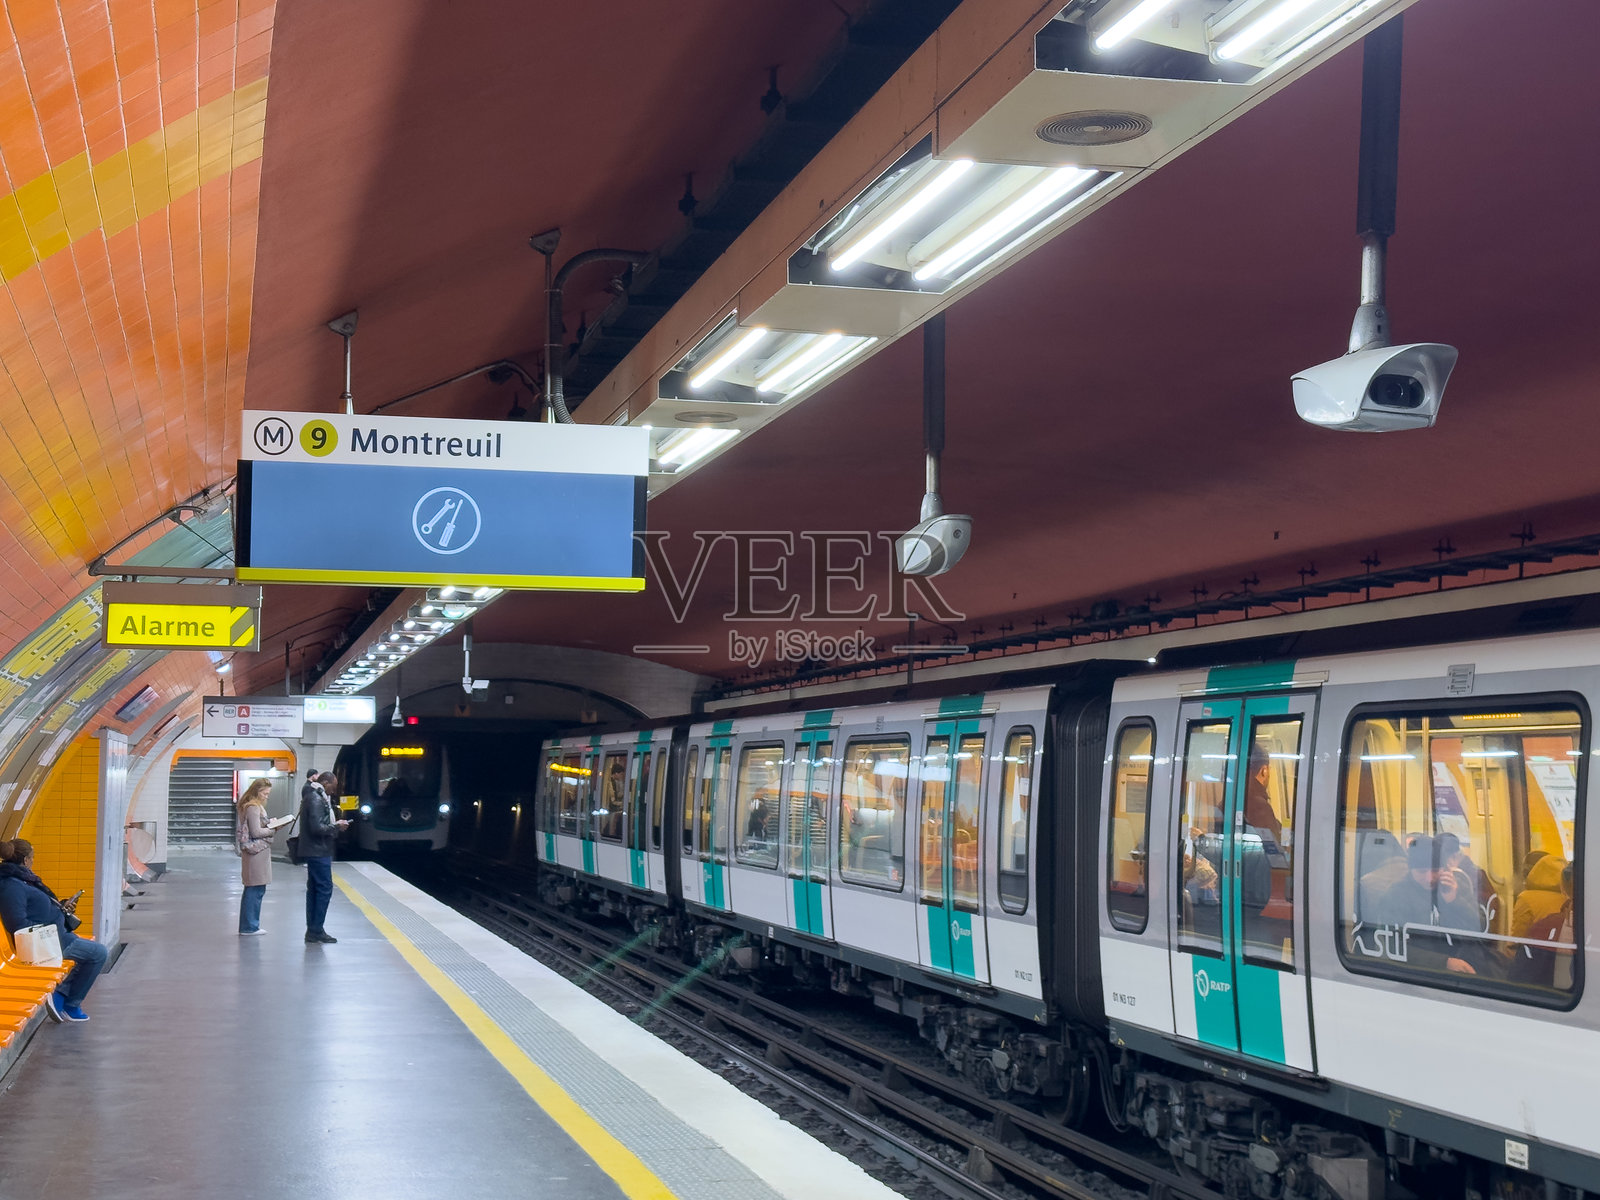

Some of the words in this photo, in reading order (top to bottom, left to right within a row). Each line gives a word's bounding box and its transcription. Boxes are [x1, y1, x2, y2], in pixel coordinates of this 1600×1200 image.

[311, 427, 327, 450] 9
[350, 427, 502, 459] Montreuil
[120, 614, 215, 638] Alarme
[240, 708, 248, 716] A
[1210, 980, 1231, 993] RATP
[1126, 995, 1136, 1007] 127
